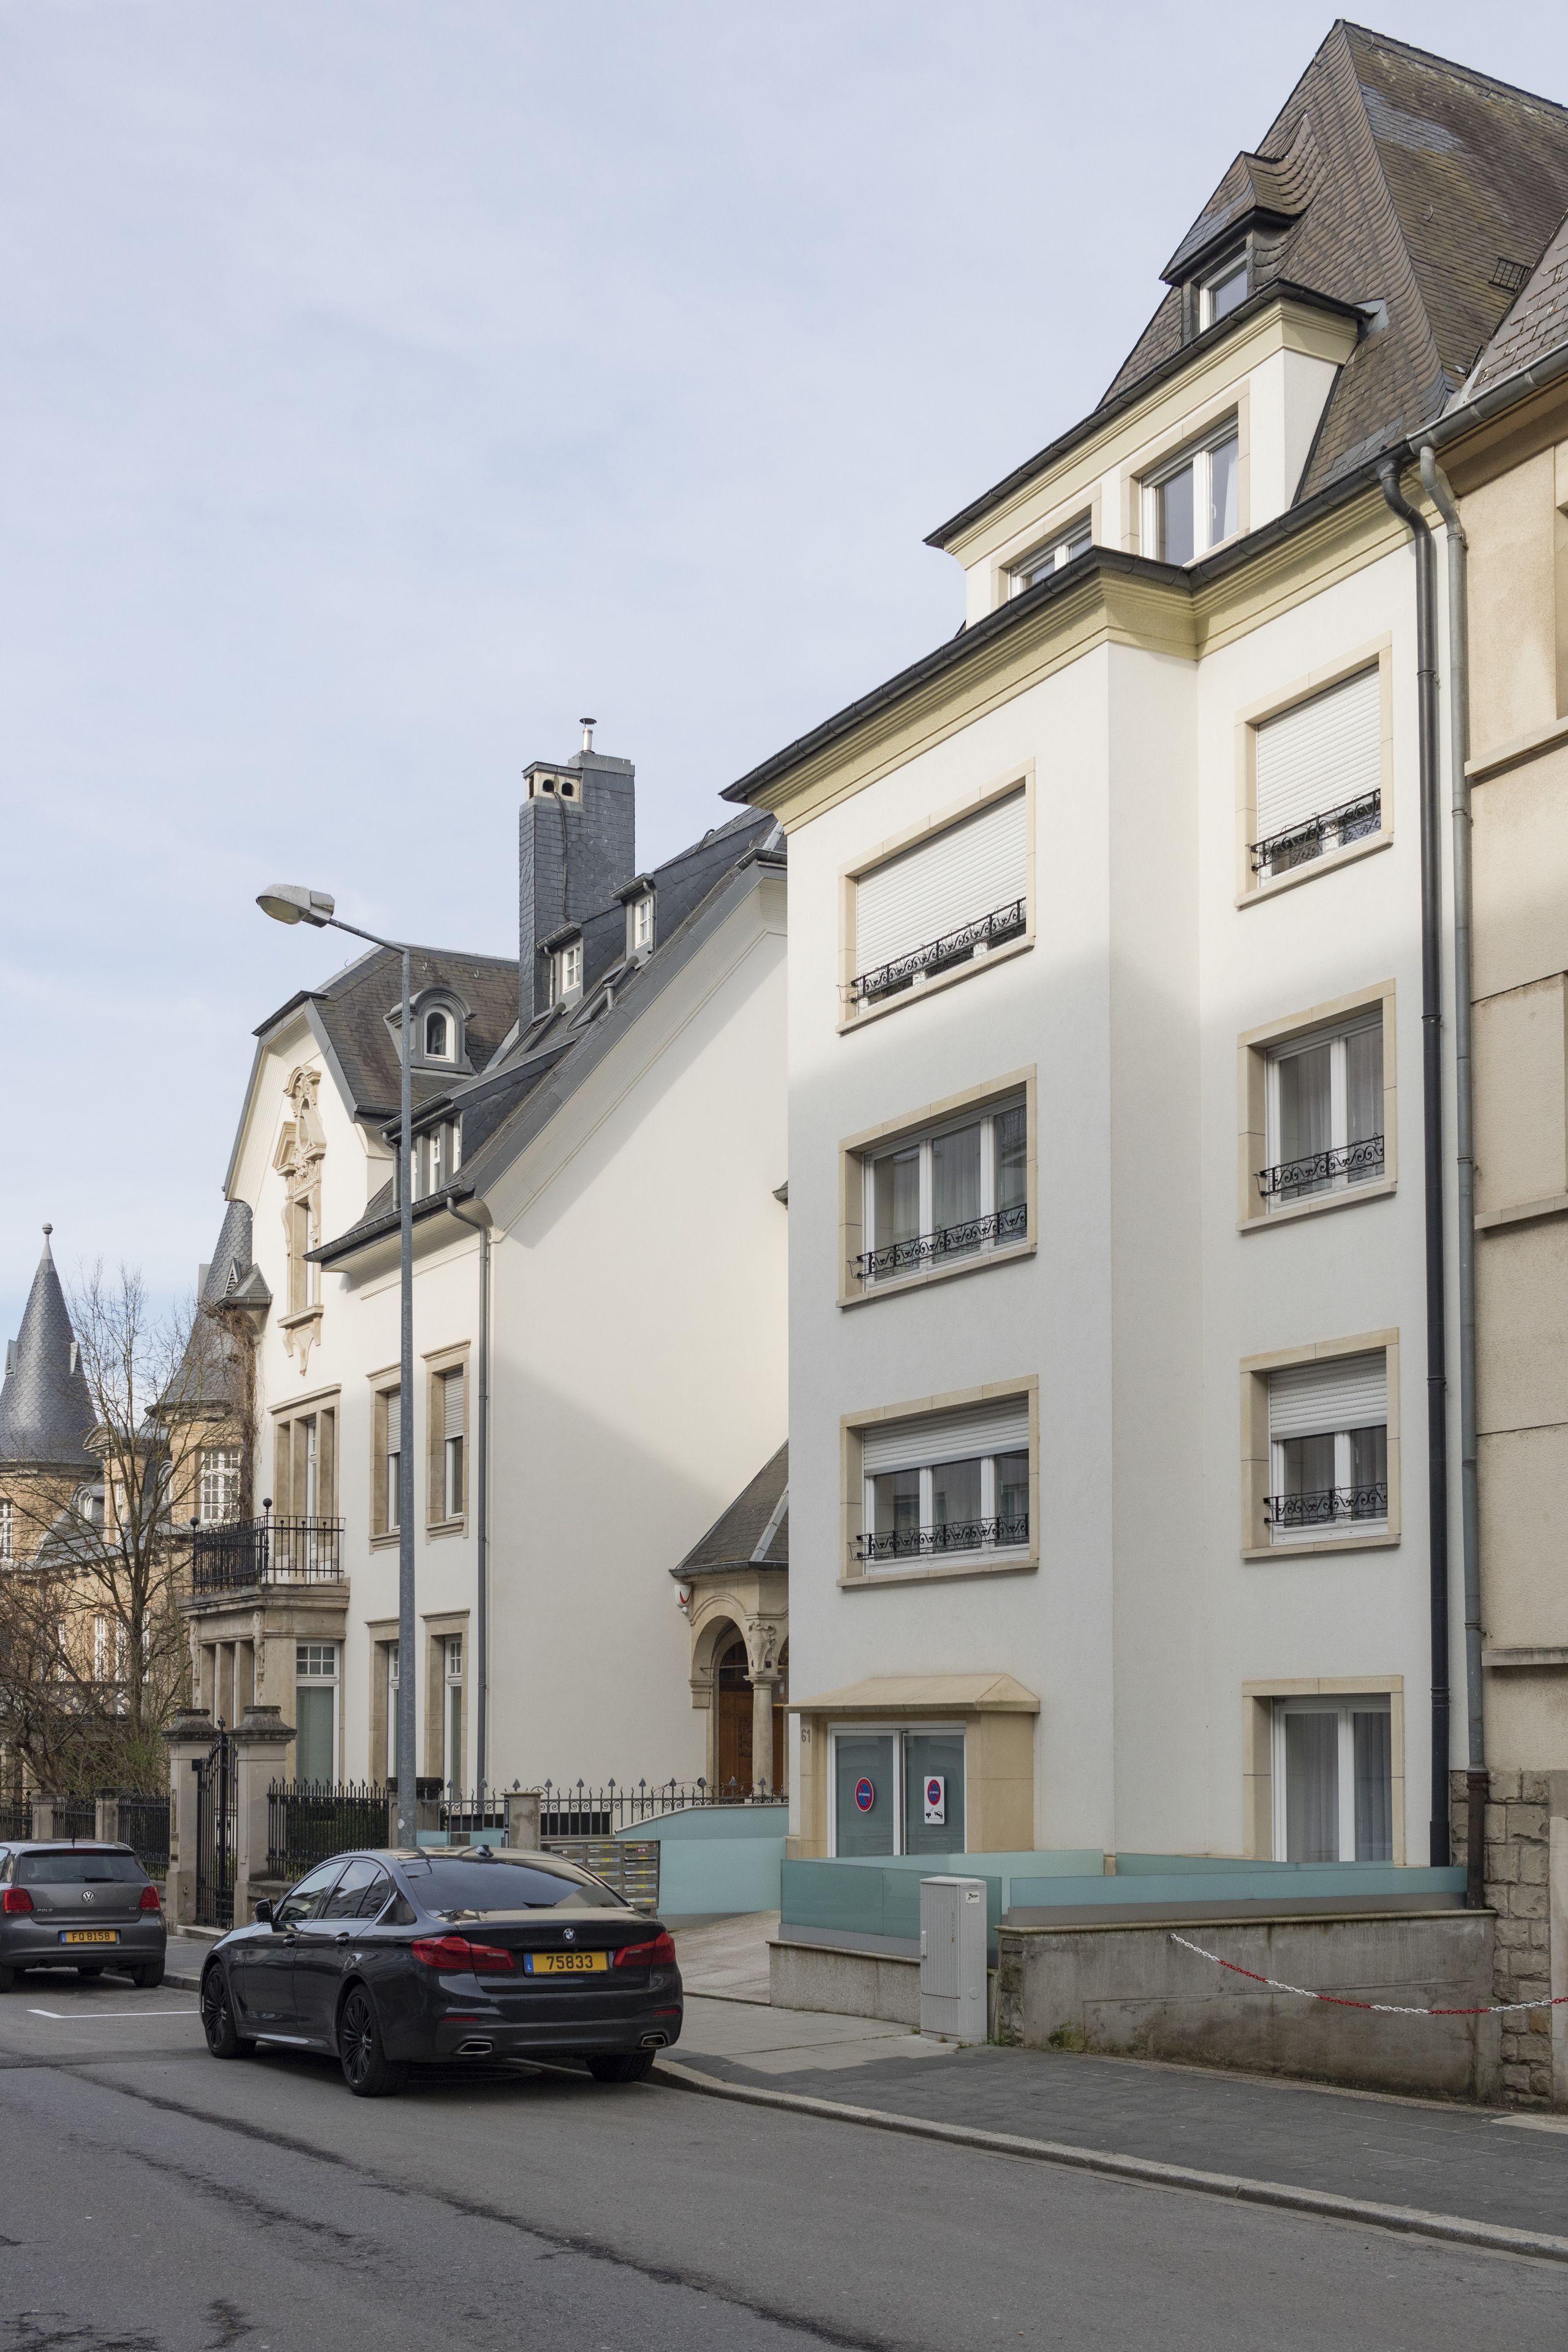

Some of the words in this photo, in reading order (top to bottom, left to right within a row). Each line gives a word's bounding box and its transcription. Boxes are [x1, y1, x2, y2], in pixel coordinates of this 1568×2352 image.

[802, 1728, 810, 1743] 61
[72, 1932, 85, 1941] FQ
[87, 1932, 110, 1940] 8158
[546, 1954, 594, 1970] 75833
